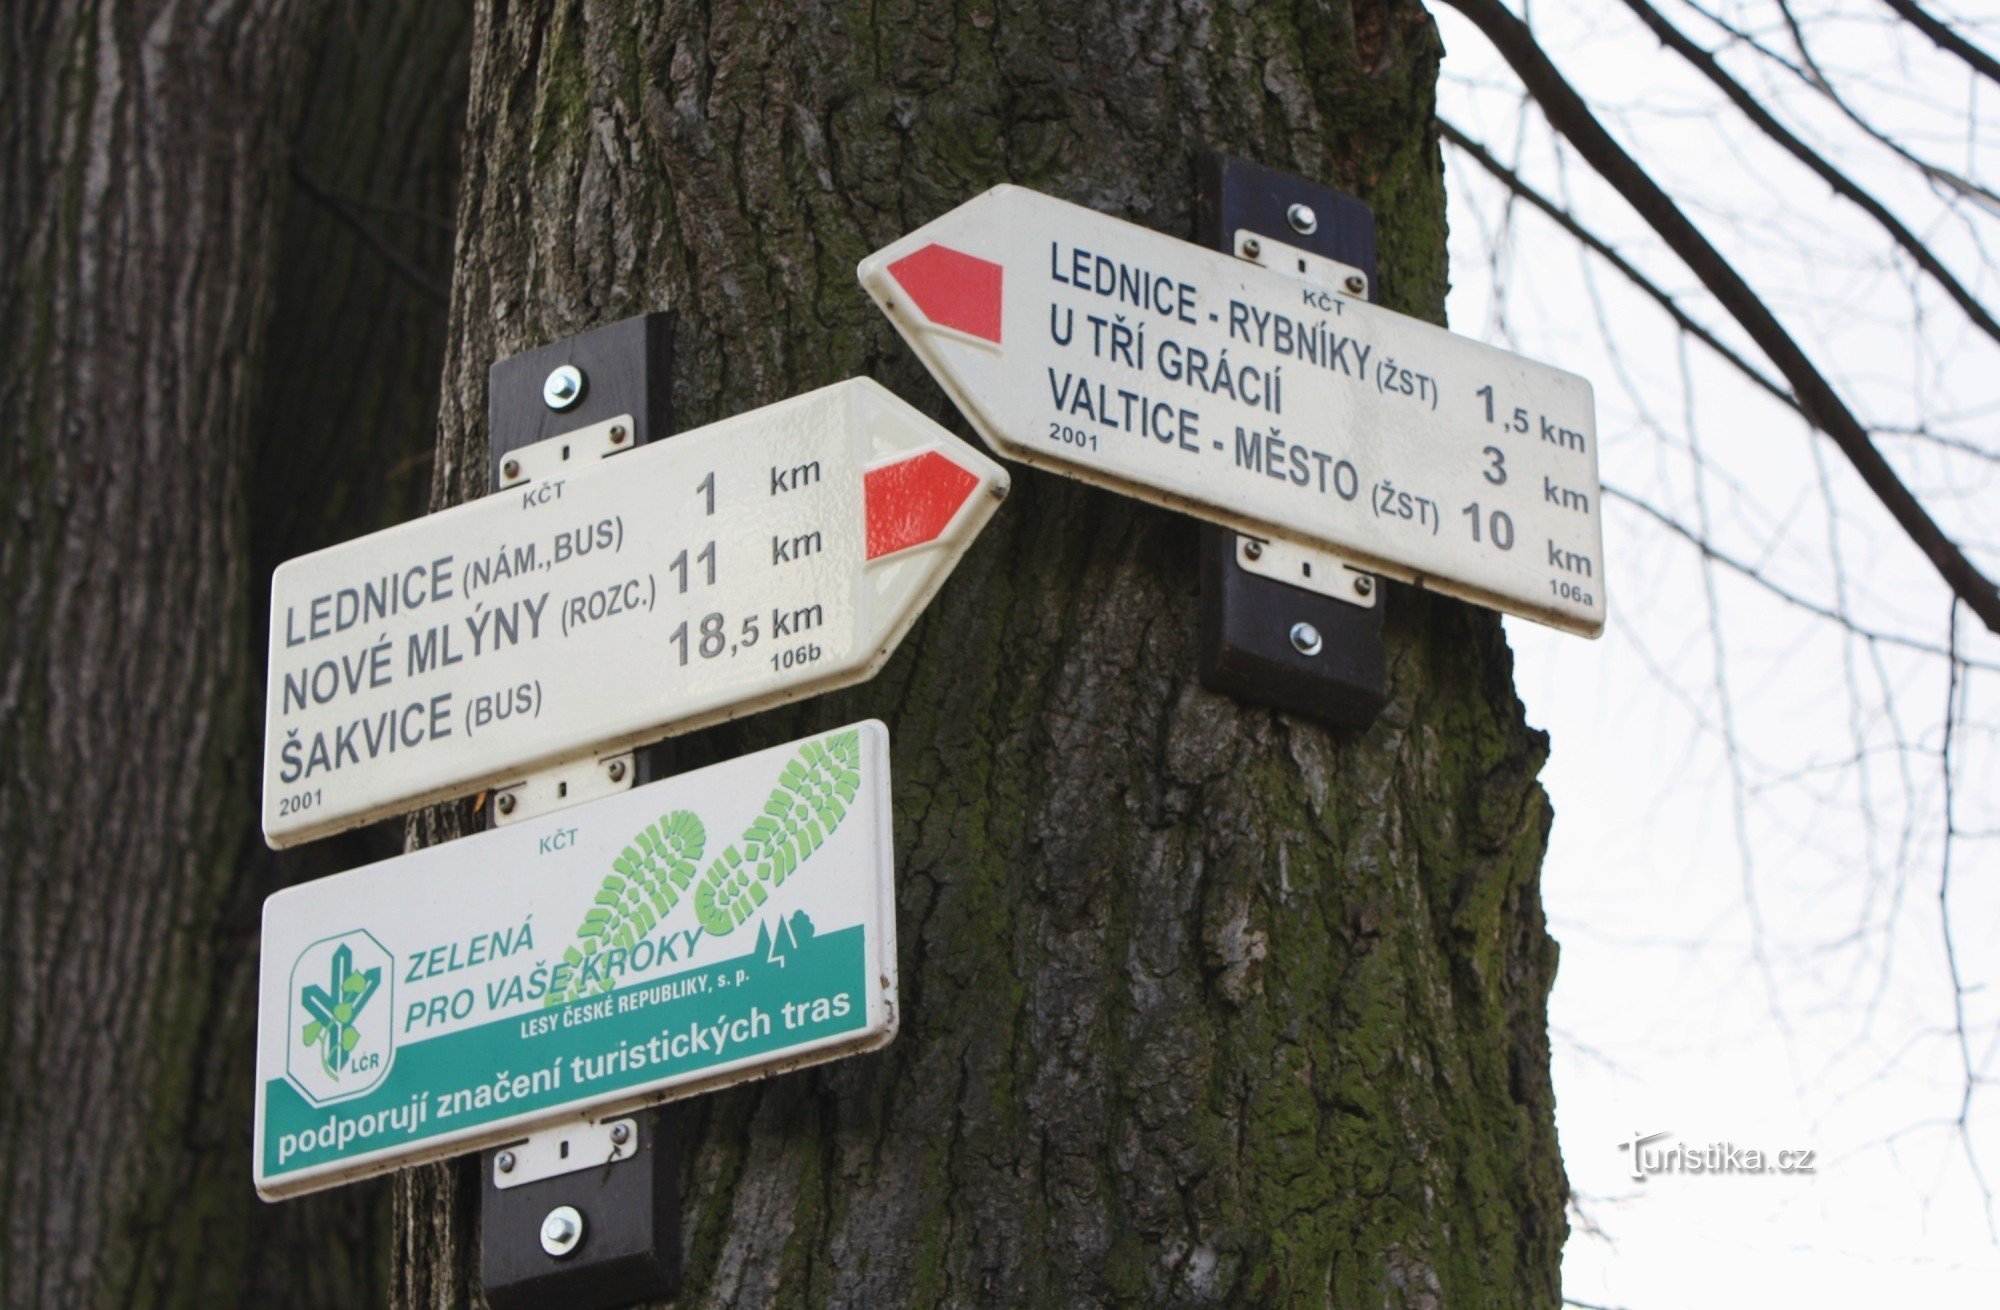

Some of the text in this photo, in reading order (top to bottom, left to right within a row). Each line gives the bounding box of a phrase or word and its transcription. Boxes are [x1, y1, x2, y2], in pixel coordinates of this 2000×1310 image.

[1303, 289, 1345, 316] KČT
[1051, 241, 1585, 453] LEDNICE - RYBNÍKY (ŽST) 1,5 km
[1049, 423, 1098, 451] 2001
[1051, 303, 1590, 514] U TŘÍ GRÁCIÍ 3 km
[523, 480, 565, 510] KČT
[1048, 367, 1592, 578] VALTICE - MĚSTO (ŽST) 10 km
[286, 555, 454, 648] LEDNICE
[696, 471, 715, 516] 1
[770, 459, 821, 496] km
[283, 529, 822, 715] NOVÉ MLÝNY (ROZC.) 11 km
[1549, 579, 1594, 607] 106a
[770, 643, 821, 672] 106b
[279, 603, 823, 784] ŠAKVICE (BUS) 18,5 km
[279, 789, 323, 817] 2001
[539, 828, 579, 855] KČT
[404, 925, 705, 1034] PRO VAŠE KROKY
[405, 914, 534, 984] ZELENÁ
[520, 969, 750, 1040] LESY ČESKÉ REPUBLIKY, s. p.
[278, 991, 850, 1165] podporují značení turistických tras
